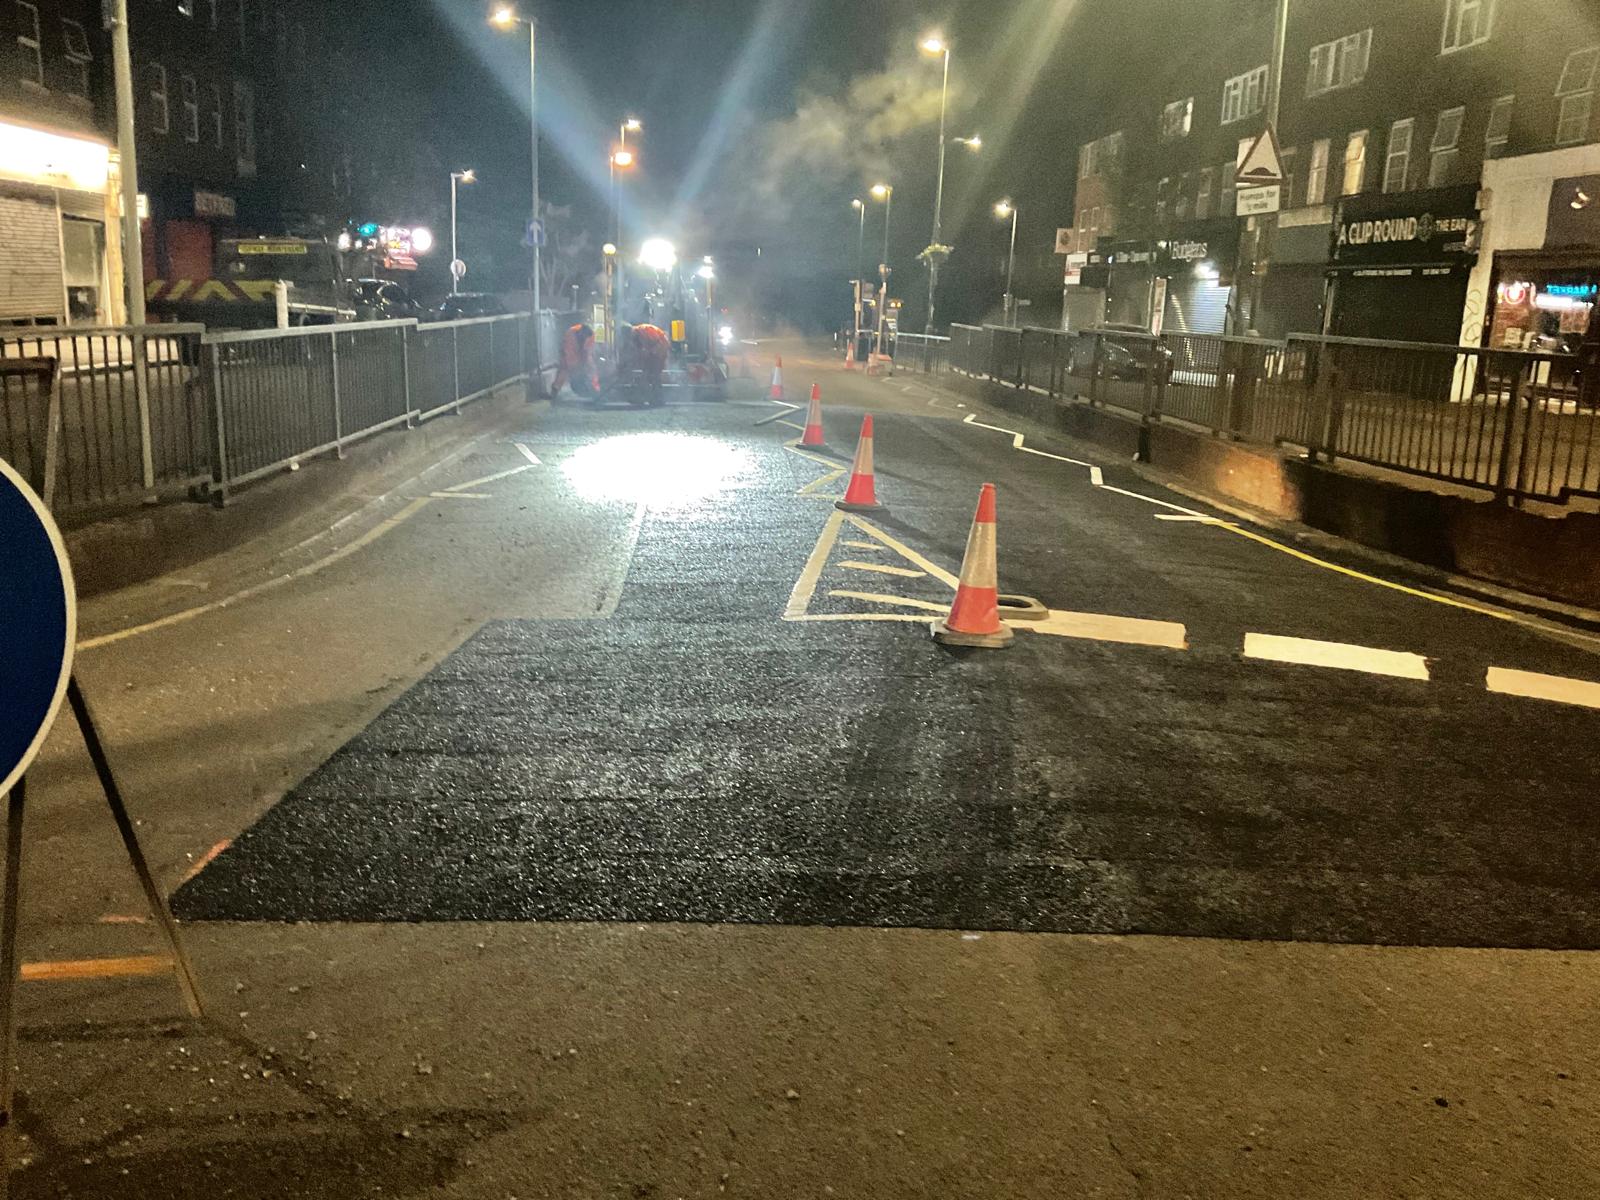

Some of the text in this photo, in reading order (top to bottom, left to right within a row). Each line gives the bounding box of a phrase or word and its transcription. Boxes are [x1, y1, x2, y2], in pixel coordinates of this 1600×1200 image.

[1336, 224, 1347, 245] A
[1348, 220, 1373, 245] CLIP
[1373, 216, 1418, 243] ROUND
[1435, 218, 1450, 232] THE
[1171, 240, 1208, 262] Budgens
